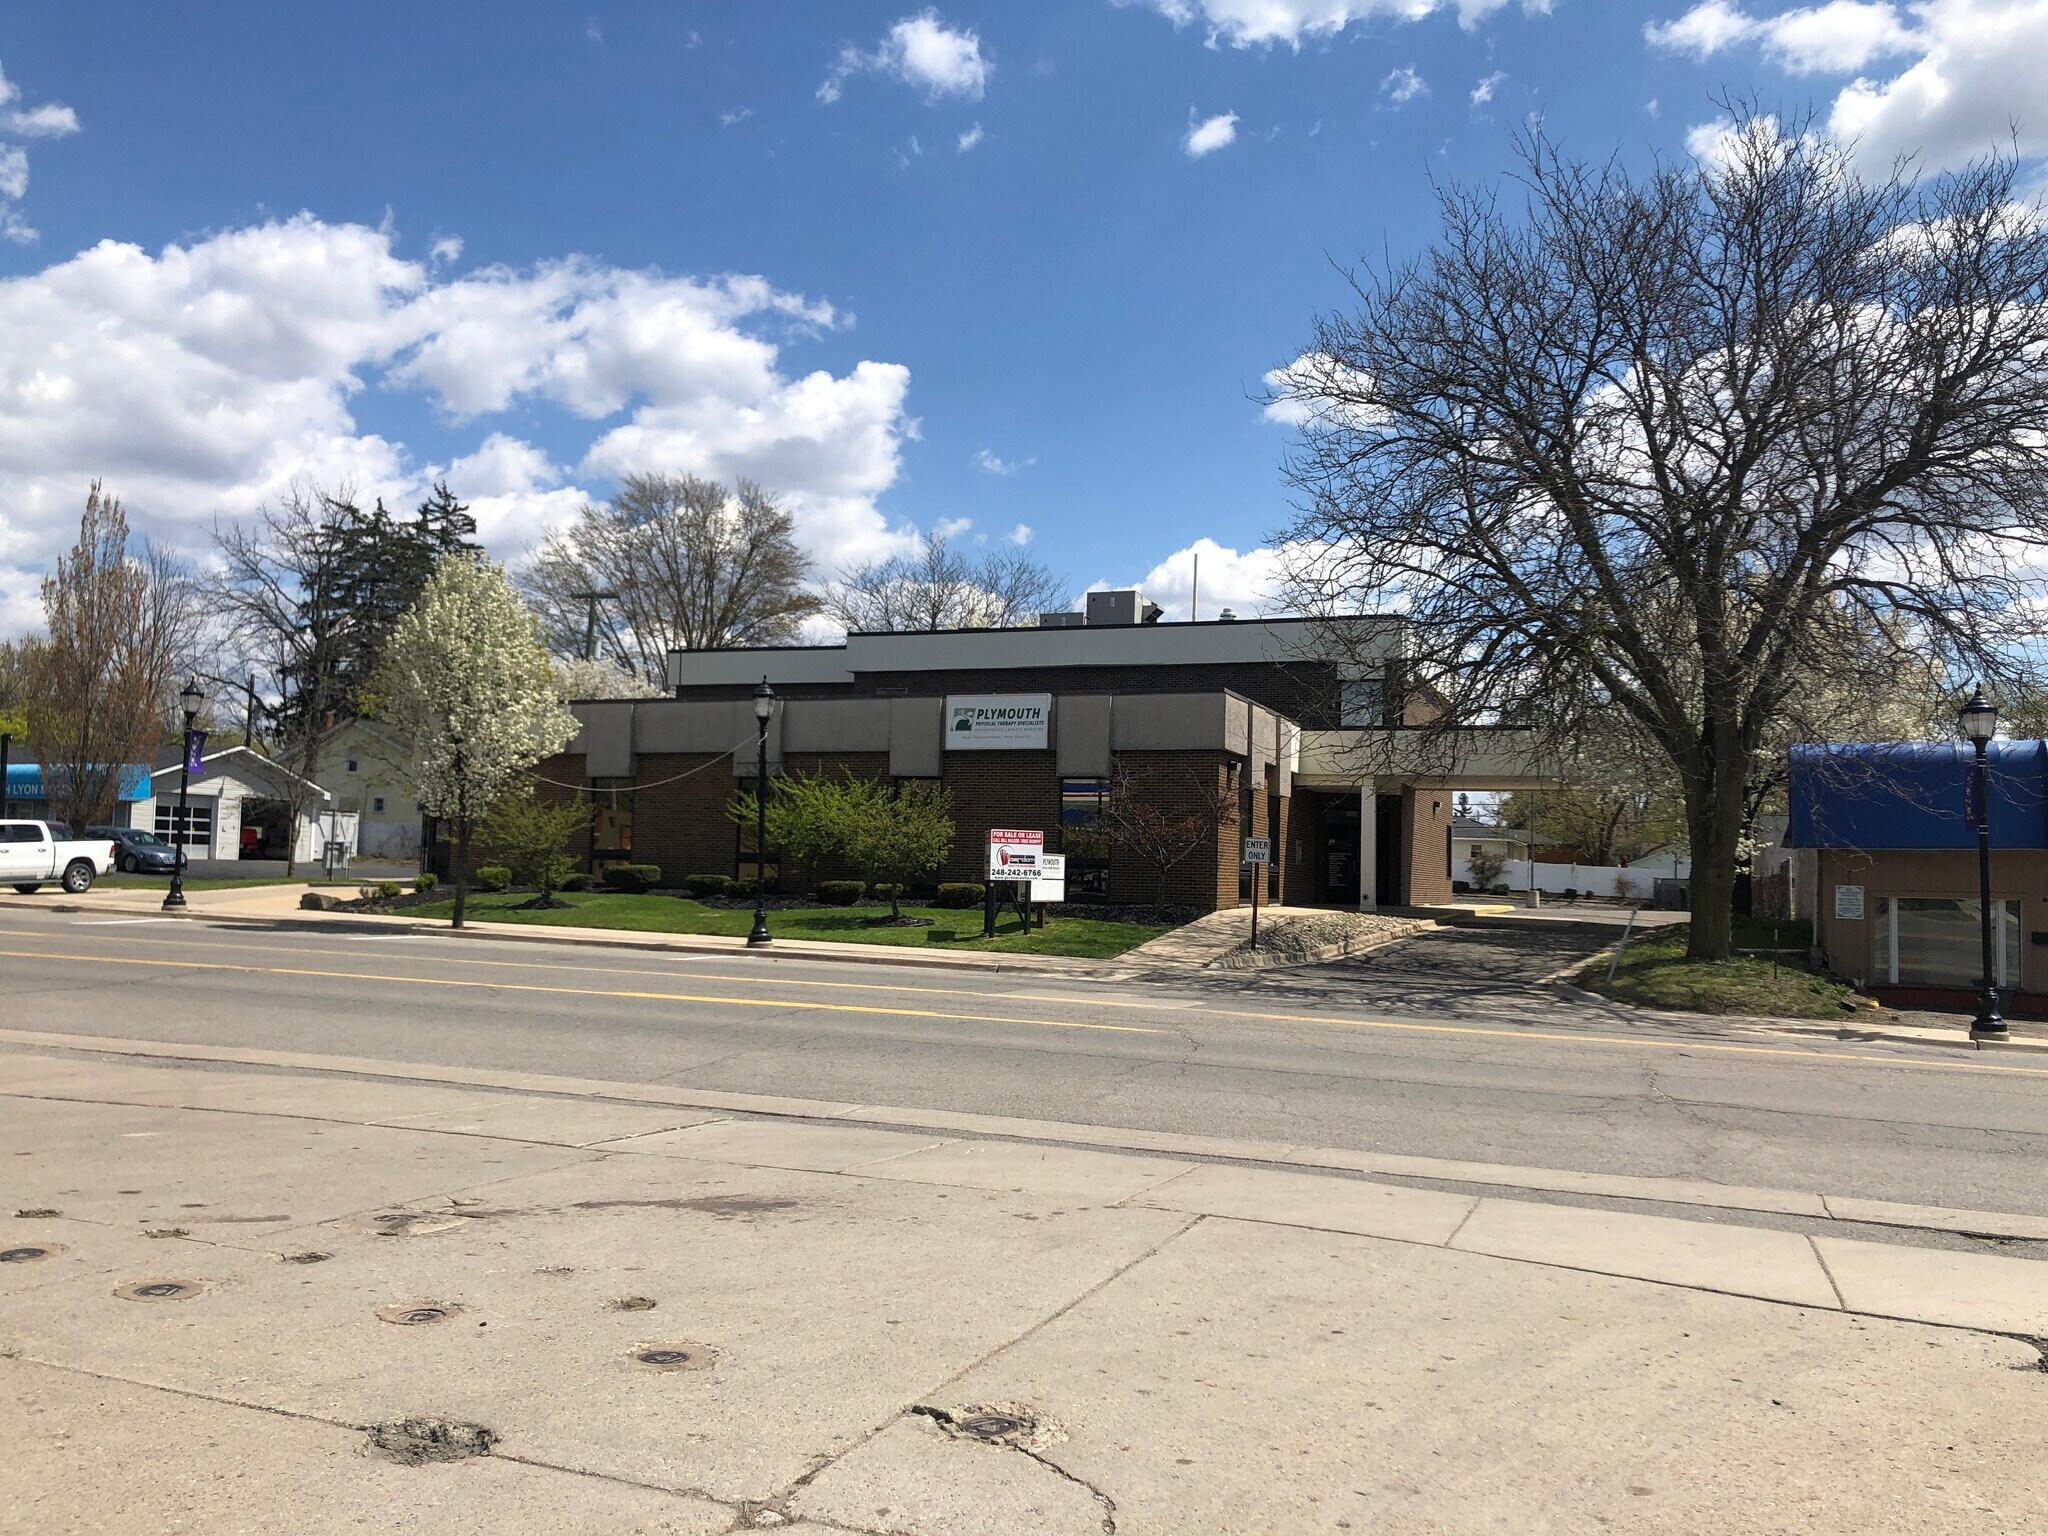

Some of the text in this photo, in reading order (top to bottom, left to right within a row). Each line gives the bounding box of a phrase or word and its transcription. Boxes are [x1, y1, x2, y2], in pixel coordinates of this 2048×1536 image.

[976, 708, 1041, 719] PLYMOUTH
[13, 784, 38, 796] LYON
[1246, 841, 1268, 849] ENTER
[1248, 852, 1265, 860] ONLY
